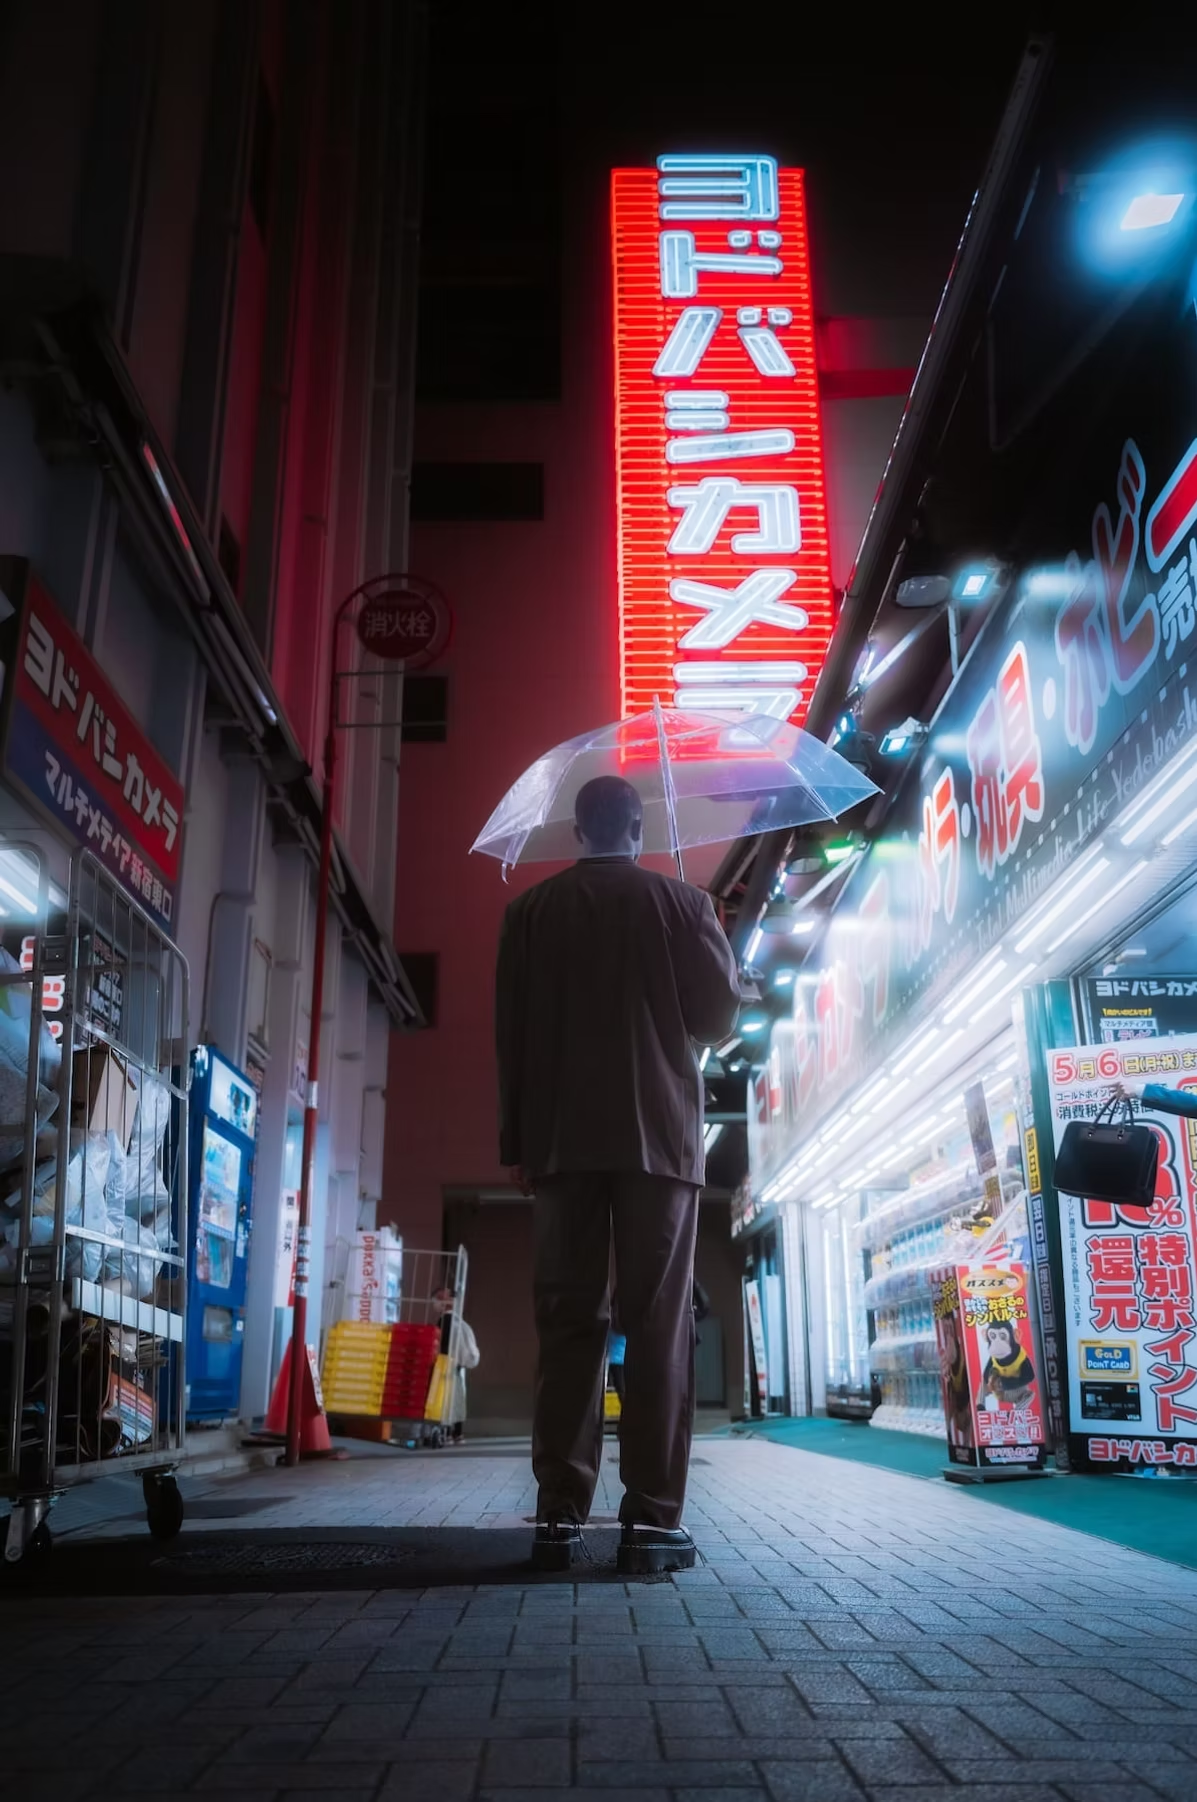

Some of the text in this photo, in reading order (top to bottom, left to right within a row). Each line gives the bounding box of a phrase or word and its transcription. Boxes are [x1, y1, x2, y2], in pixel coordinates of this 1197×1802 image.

[653, 153, 808, 745] ヨドバシカメラ
[366, 609, 432, 639] 消火栓
[24, 610, 179, 853] ヨドバシカメラ
[45, 749, 172, 923] マルチメディア新宿東口
[966, 1278, 1004, 1288] オススメ
[1085, 1233, 1142, 1333] 還元
[1136, 1231, 1197, 1432] 特別ポイント
